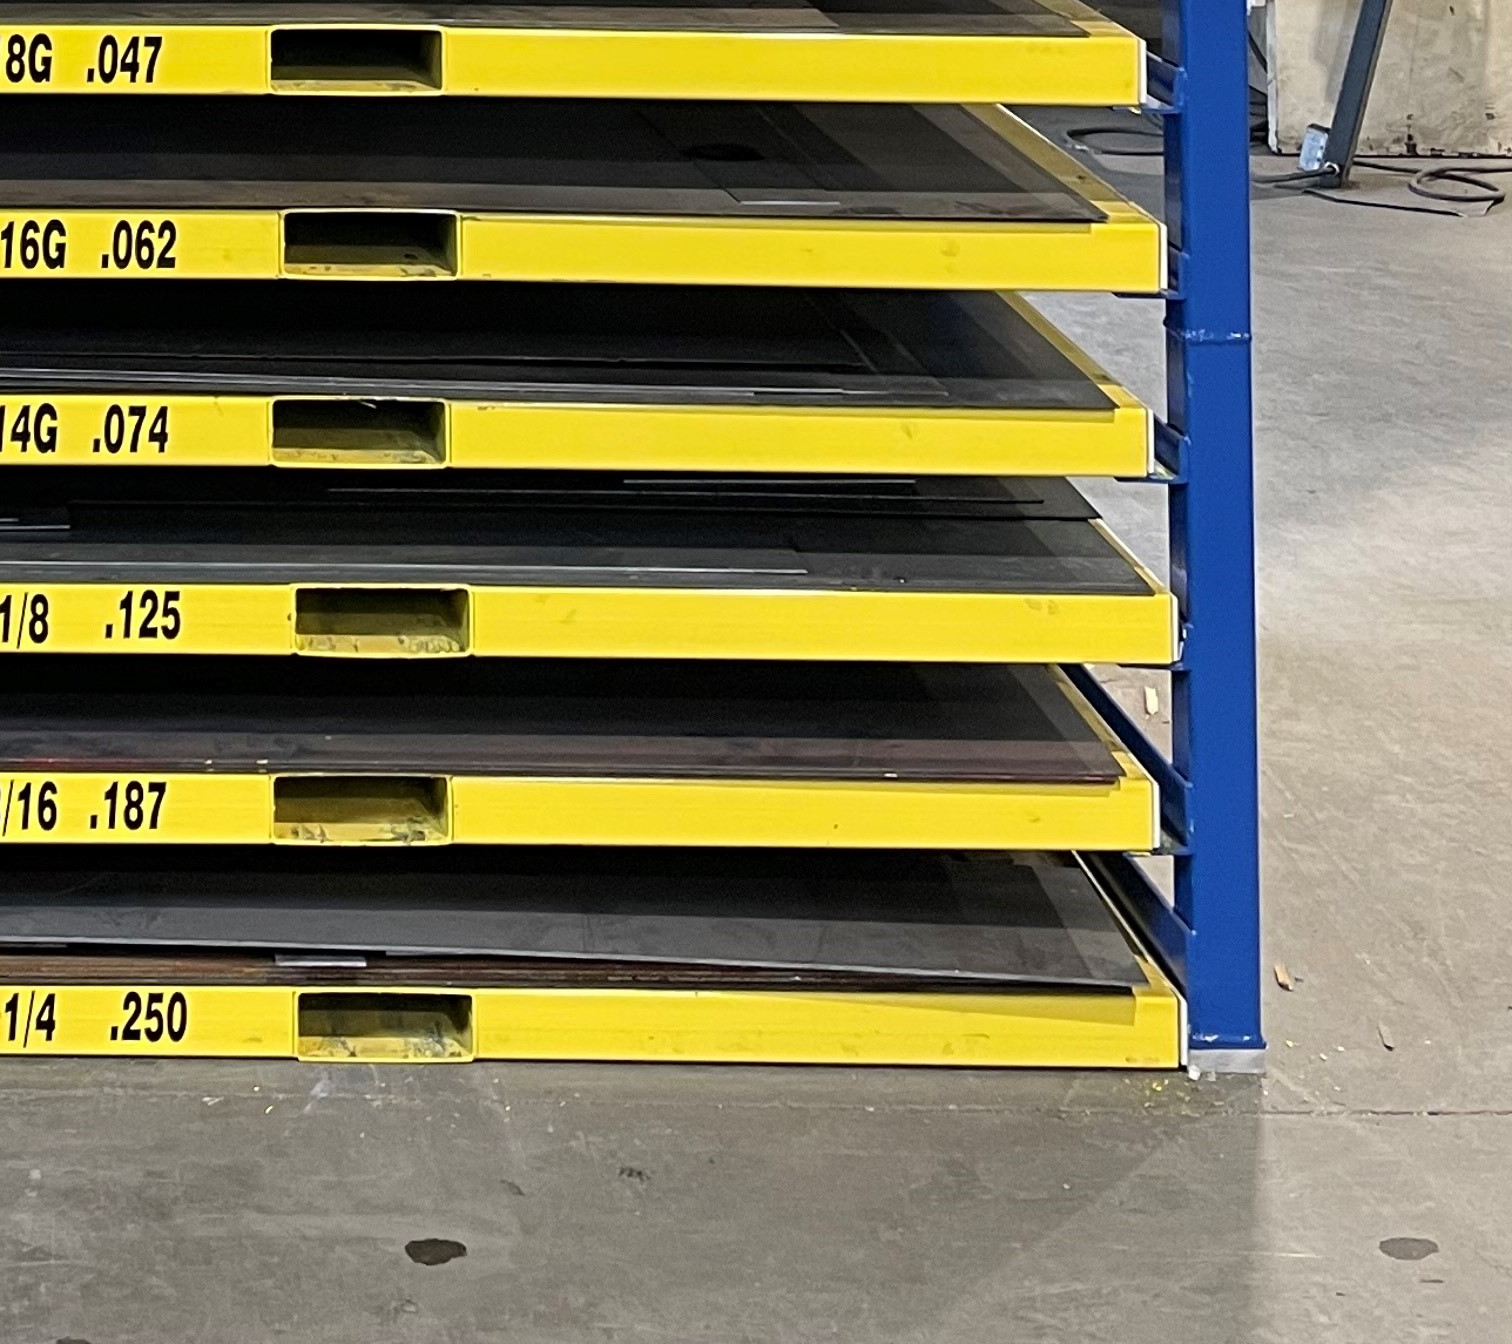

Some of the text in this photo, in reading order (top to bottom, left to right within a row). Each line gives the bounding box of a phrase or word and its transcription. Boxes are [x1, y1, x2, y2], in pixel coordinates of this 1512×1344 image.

[86, 34, 164, 85] .047
[0, 218, 67, 271] 16G
[100, 218, 178, 271] .062
[91, 403, 169, 455] .074
[104, 589, 182, 642] .125
[89, 780, 168, 832] .187
[3, 988, 57, 1048] 1/4
[109, 990, 188, 1044] .250
